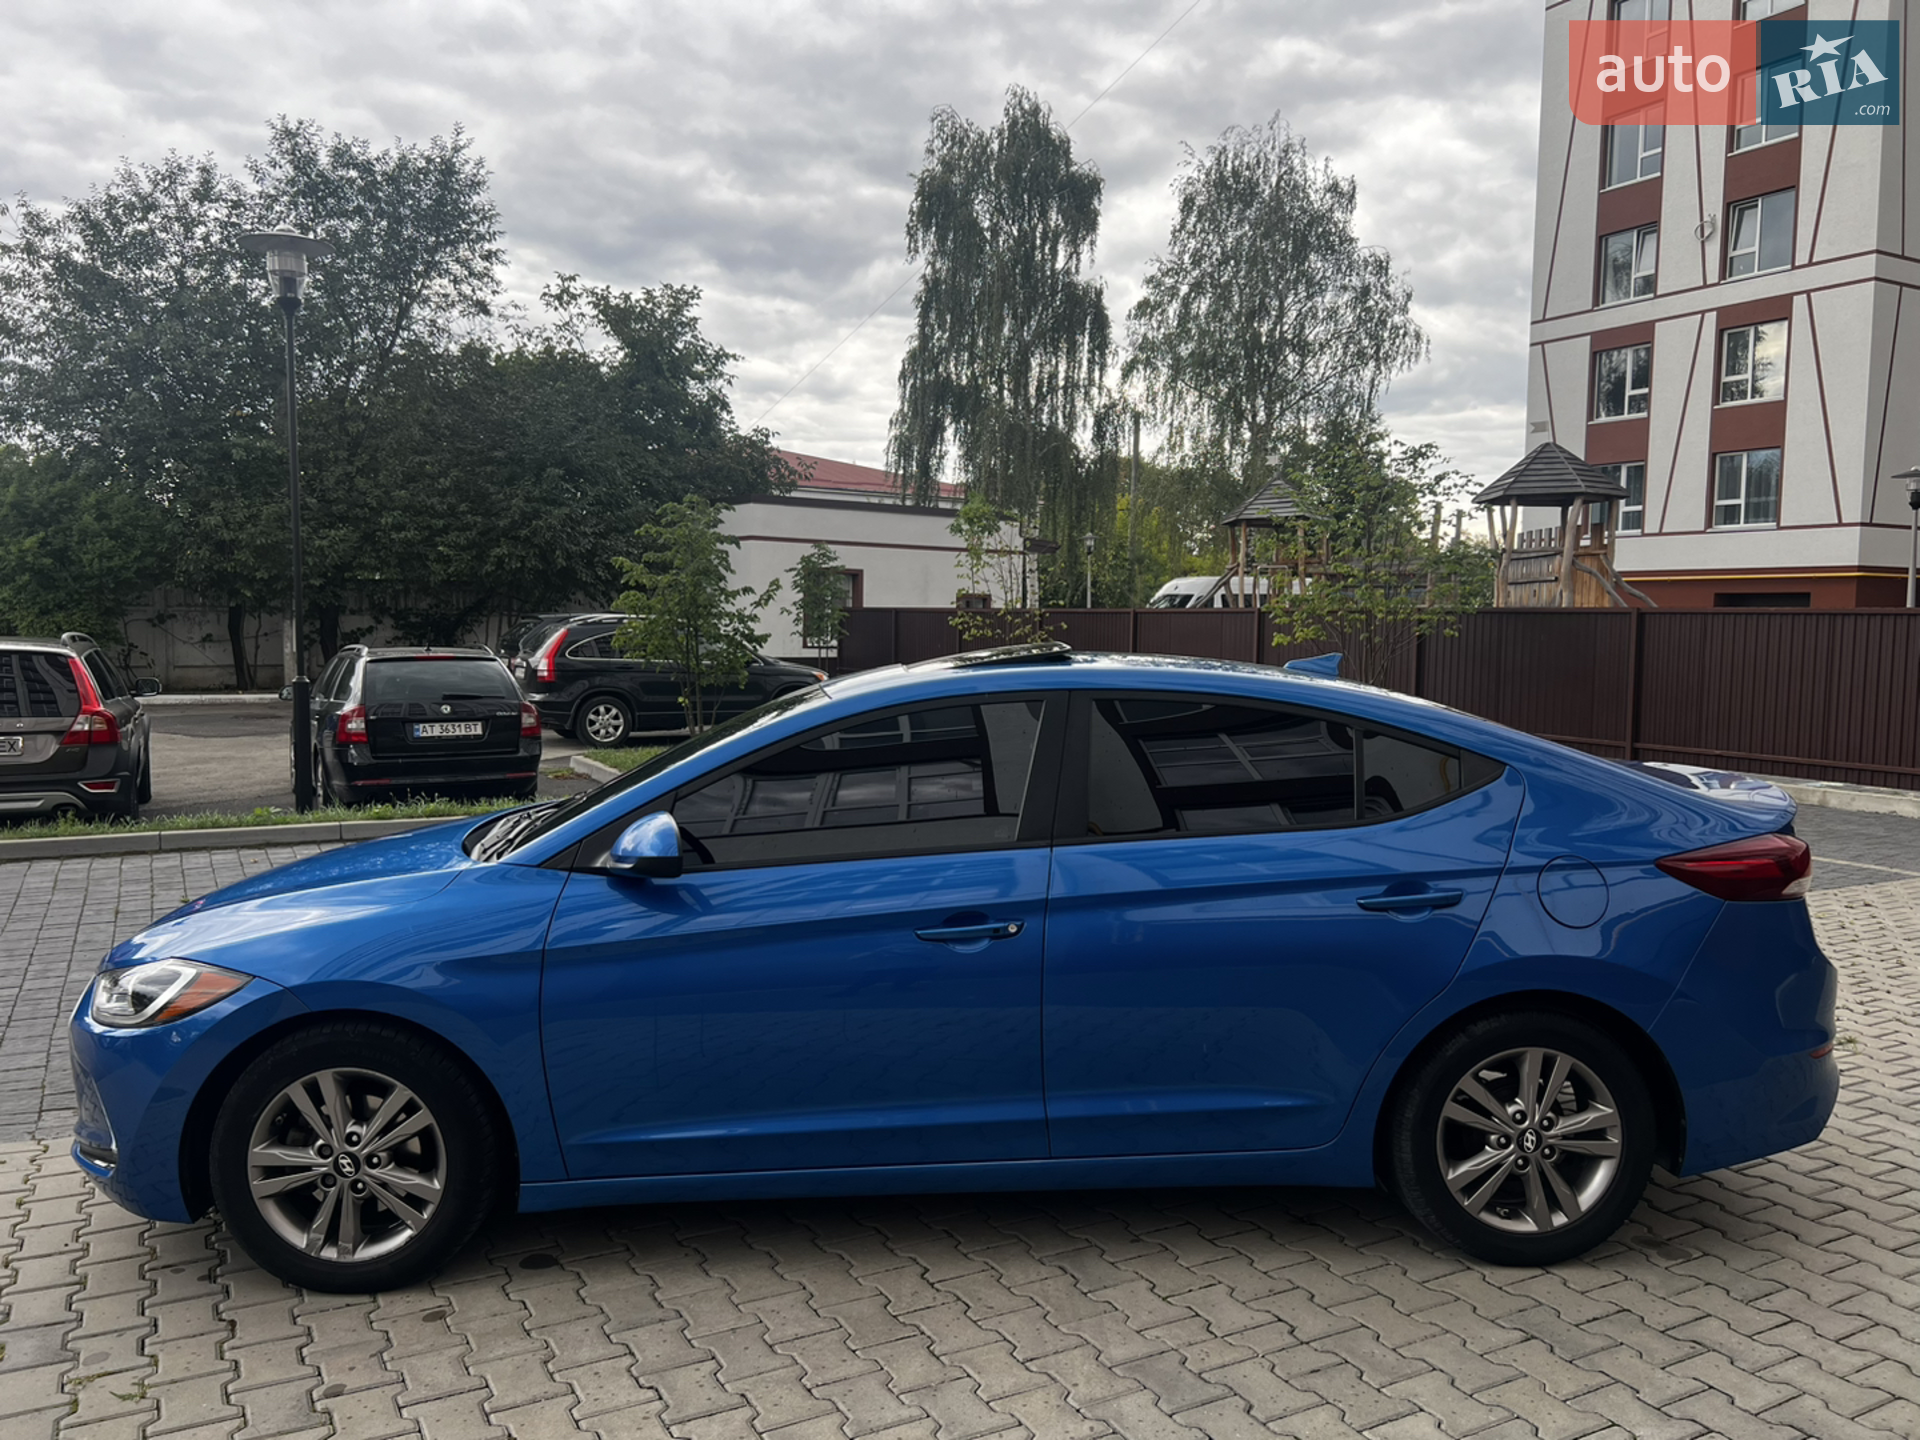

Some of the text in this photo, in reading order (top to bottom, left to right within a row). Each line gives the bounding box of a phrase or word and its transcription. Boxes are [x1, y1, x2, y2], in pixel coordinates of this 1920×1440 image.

[421, 723, 479, 735] AT 3631 BT
